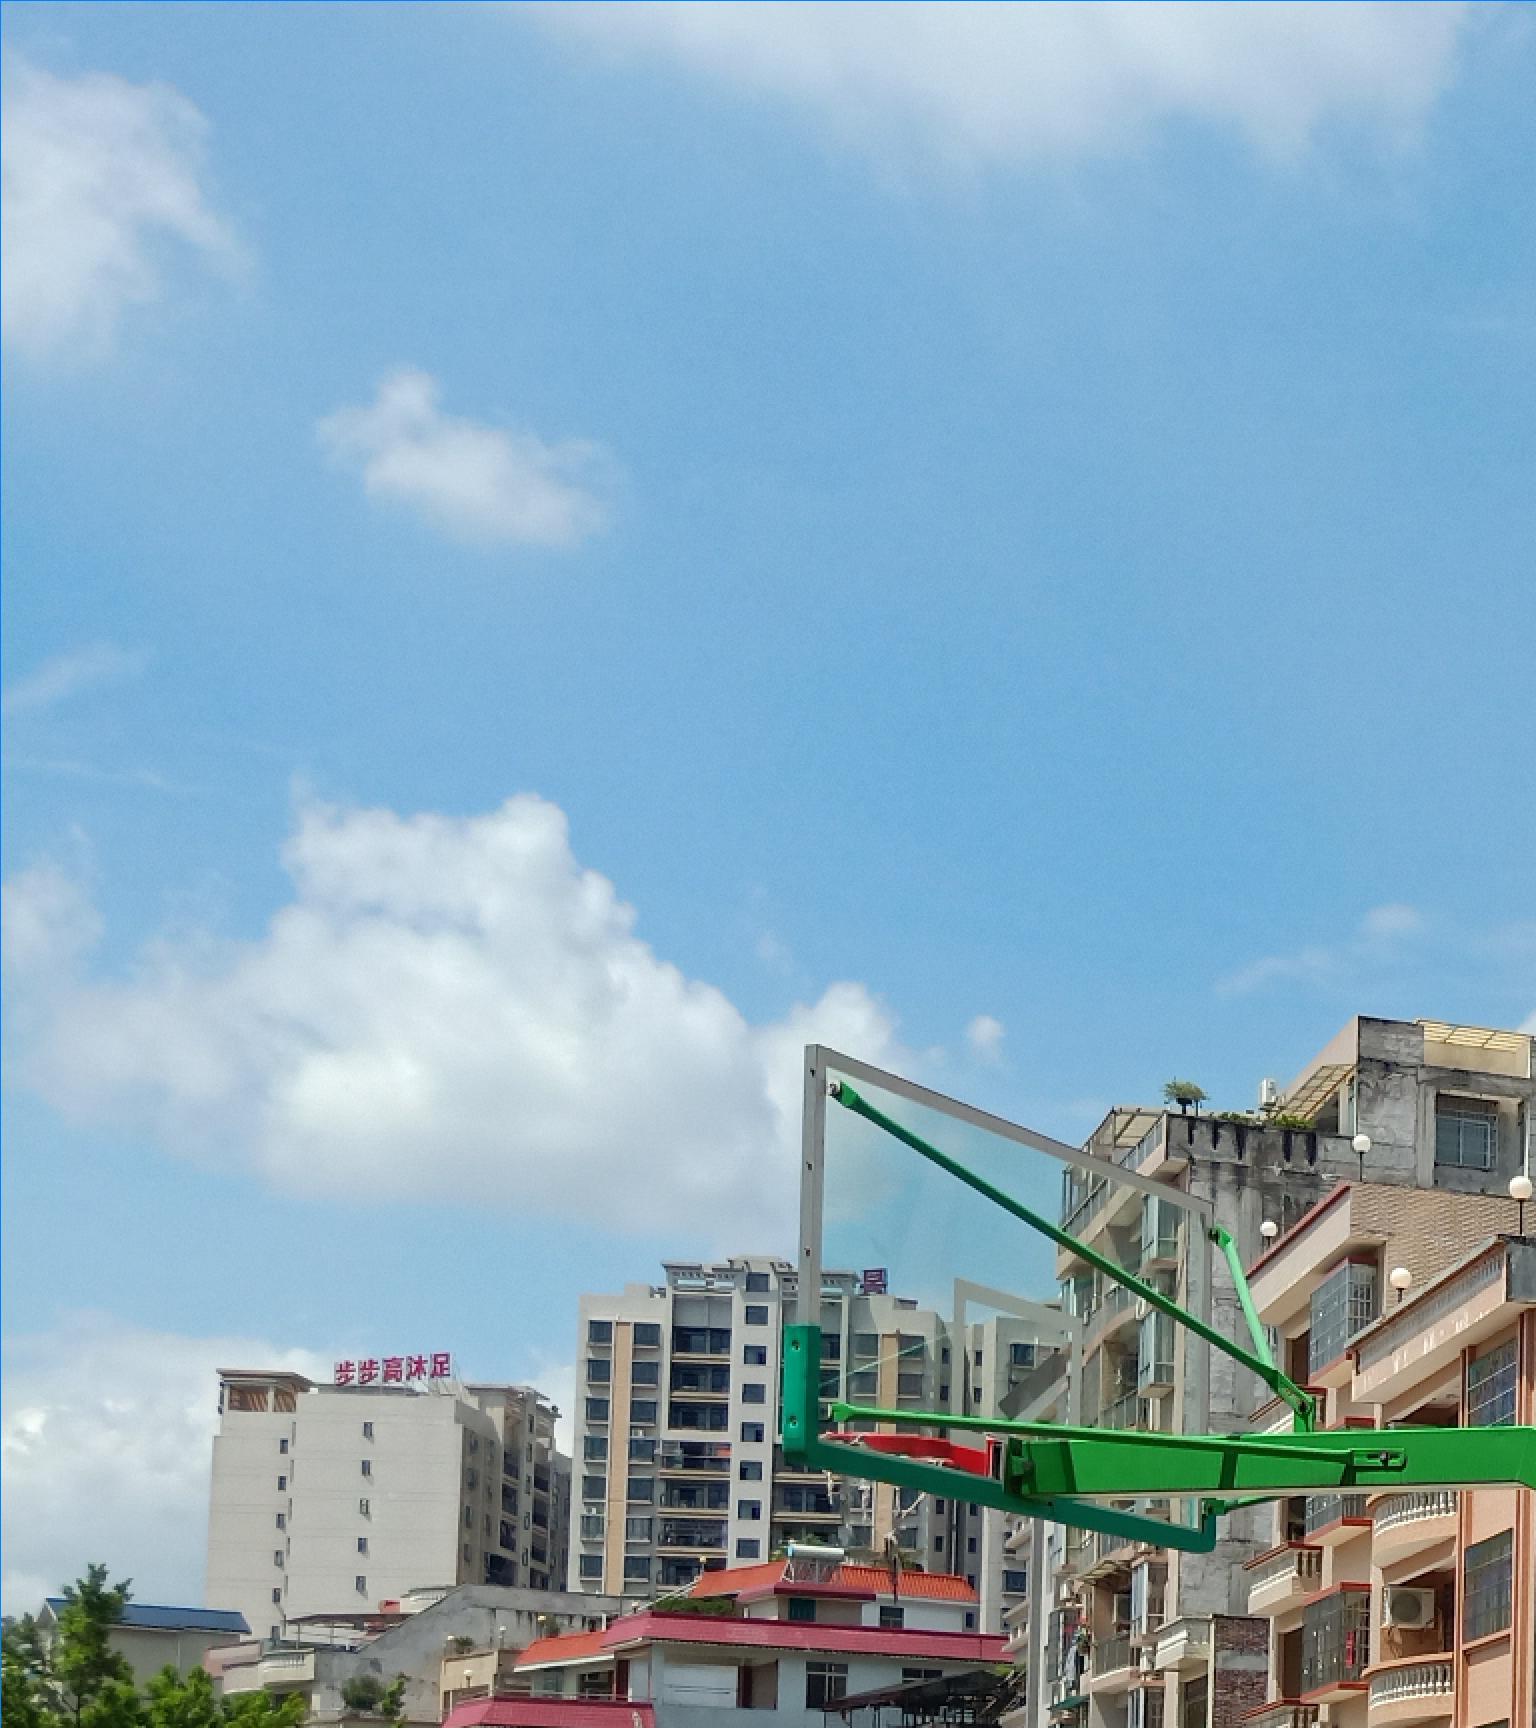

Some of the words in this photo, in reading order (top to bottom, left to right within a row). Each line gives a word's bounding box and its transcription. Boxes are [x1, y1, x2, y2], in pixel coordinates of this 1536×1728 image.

[335, 1352, 451, 1386] 步步高沐足
